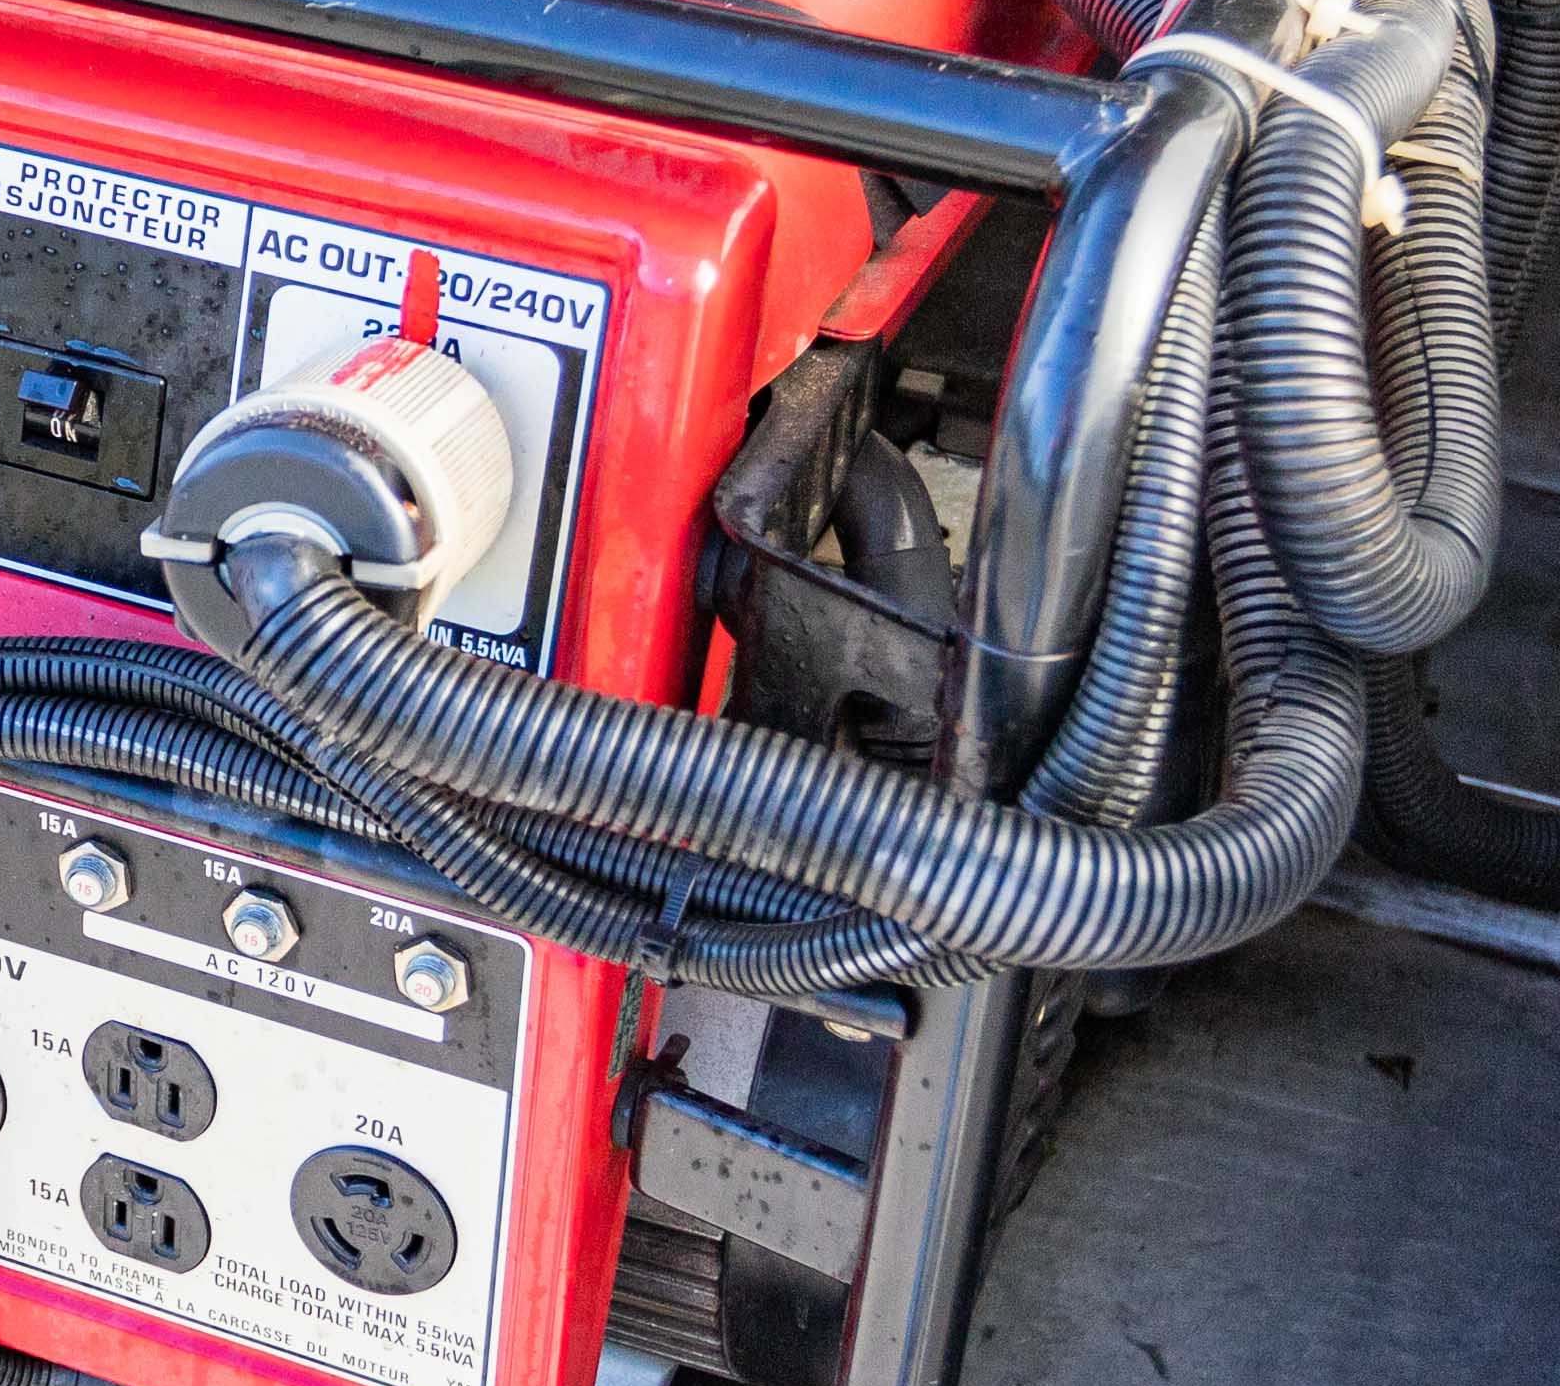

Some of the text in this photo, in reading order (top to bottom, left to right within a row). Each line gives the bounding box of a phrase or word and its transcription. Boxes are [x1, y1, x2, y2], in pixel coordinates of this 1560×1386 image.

[20, 161, 222, 228] PROTECTOR
[257, 228, 309, 264] AC
[49, 416, 79, 445] ON
[460, 632, 526, 669] 5.5kVA
[38, 811, 78, 840] 15A
[202, 858, 243, 887] 15A
[75, 881, 93, 897] 15
[368, 905, 415, 936] 20A
[241, 931, 260, 948] 15
[206, 952, 318, 999] AC 120V
[414, 982, 434, 999] 20
[31, 1028, 73, 1058] 15A
[354, 1114, 405, 1146] 20A
[29, 1178, 71, 1207] 15A
[7, 1228, 68, 1259] BONDED
[80, 1252, 99, 1269] TO
[58, 1257, 77, 1276] LA
[88, 1269, 143, 1297] MASSE
[177, 1298, 197, 1316] LA
[207, 1308, 294, 1347] CARCASSE
[306, 1340, 329, 1359] DU
[215, 1254, 271, 1286] TOTAL
[279, 1275, 328, 1304] LOAD
[337, 1293, 408, 1330] WITHIN
[416, 1319, 476, 1352] 5.5kVA
[213, 1272, 475, 1370] CHARGE TOTALE MAX. 5.5kVA
